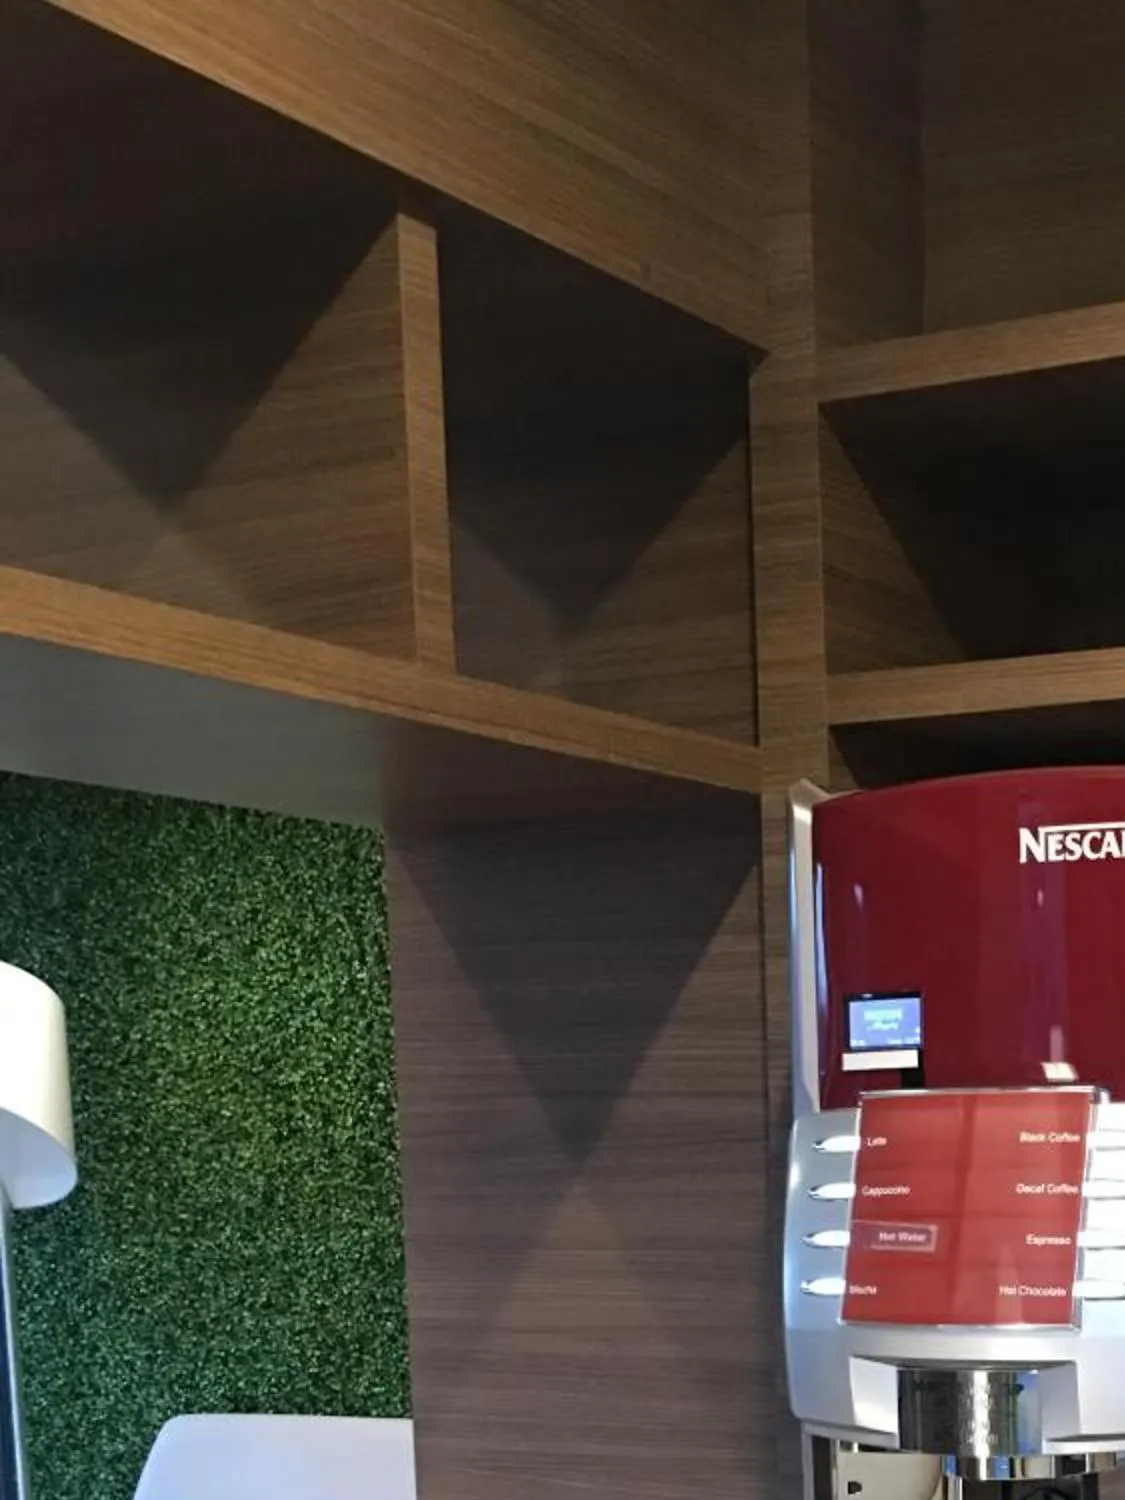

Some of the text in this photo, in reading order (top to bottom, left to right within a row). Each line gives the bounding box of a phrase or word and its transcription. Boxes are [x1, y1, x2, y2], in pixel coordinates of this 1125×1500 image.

[1047, 1131, 1081, 1144] Coffee
[1016, 1183, 1079, 1195] Decaf Coffee
[897, 1231, 927, 1243] Water
[1025, 1233, 1072, 1247] Espresso
[1018, 1284, 1067, 1297] Chocolate
